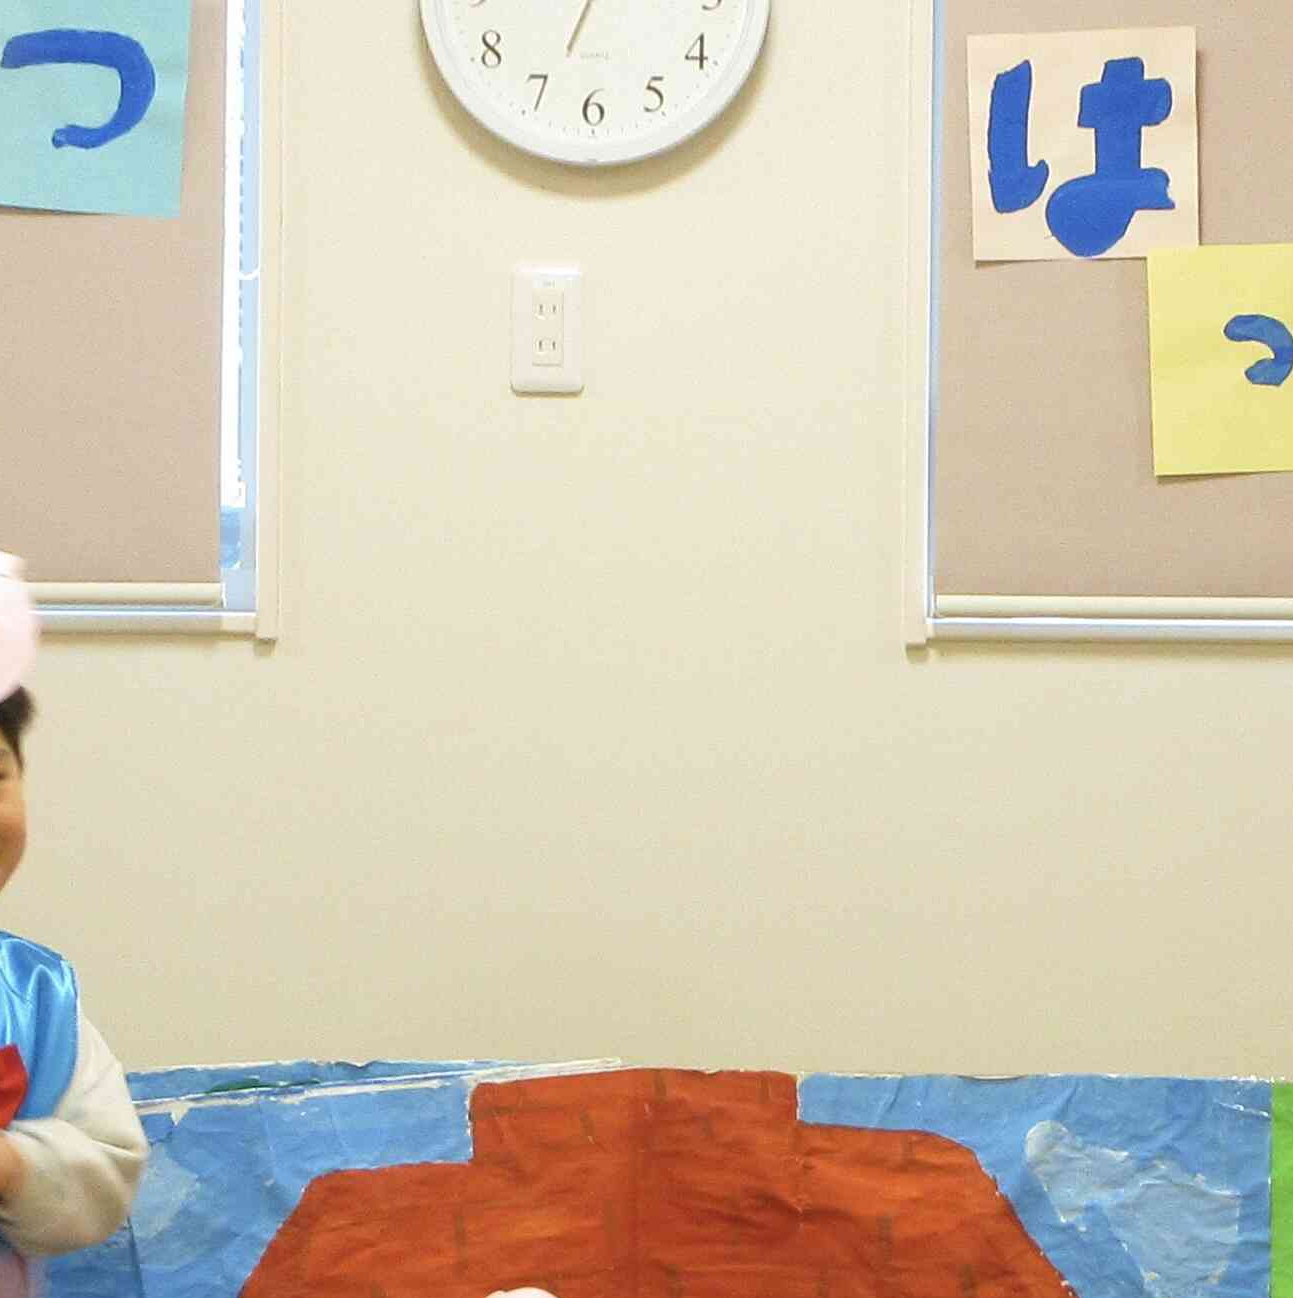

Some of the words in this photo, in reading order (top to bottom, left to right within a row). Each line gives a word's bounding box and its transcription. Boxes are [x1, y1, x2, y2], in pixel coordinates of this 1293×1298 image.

[481, 30, 502, 68] 8
[685, 33, 708, 70] 4
[526, 74, 548, 111] 7
[582, 88, 605, 126] 6
[643, 76, 665, 112] 5
